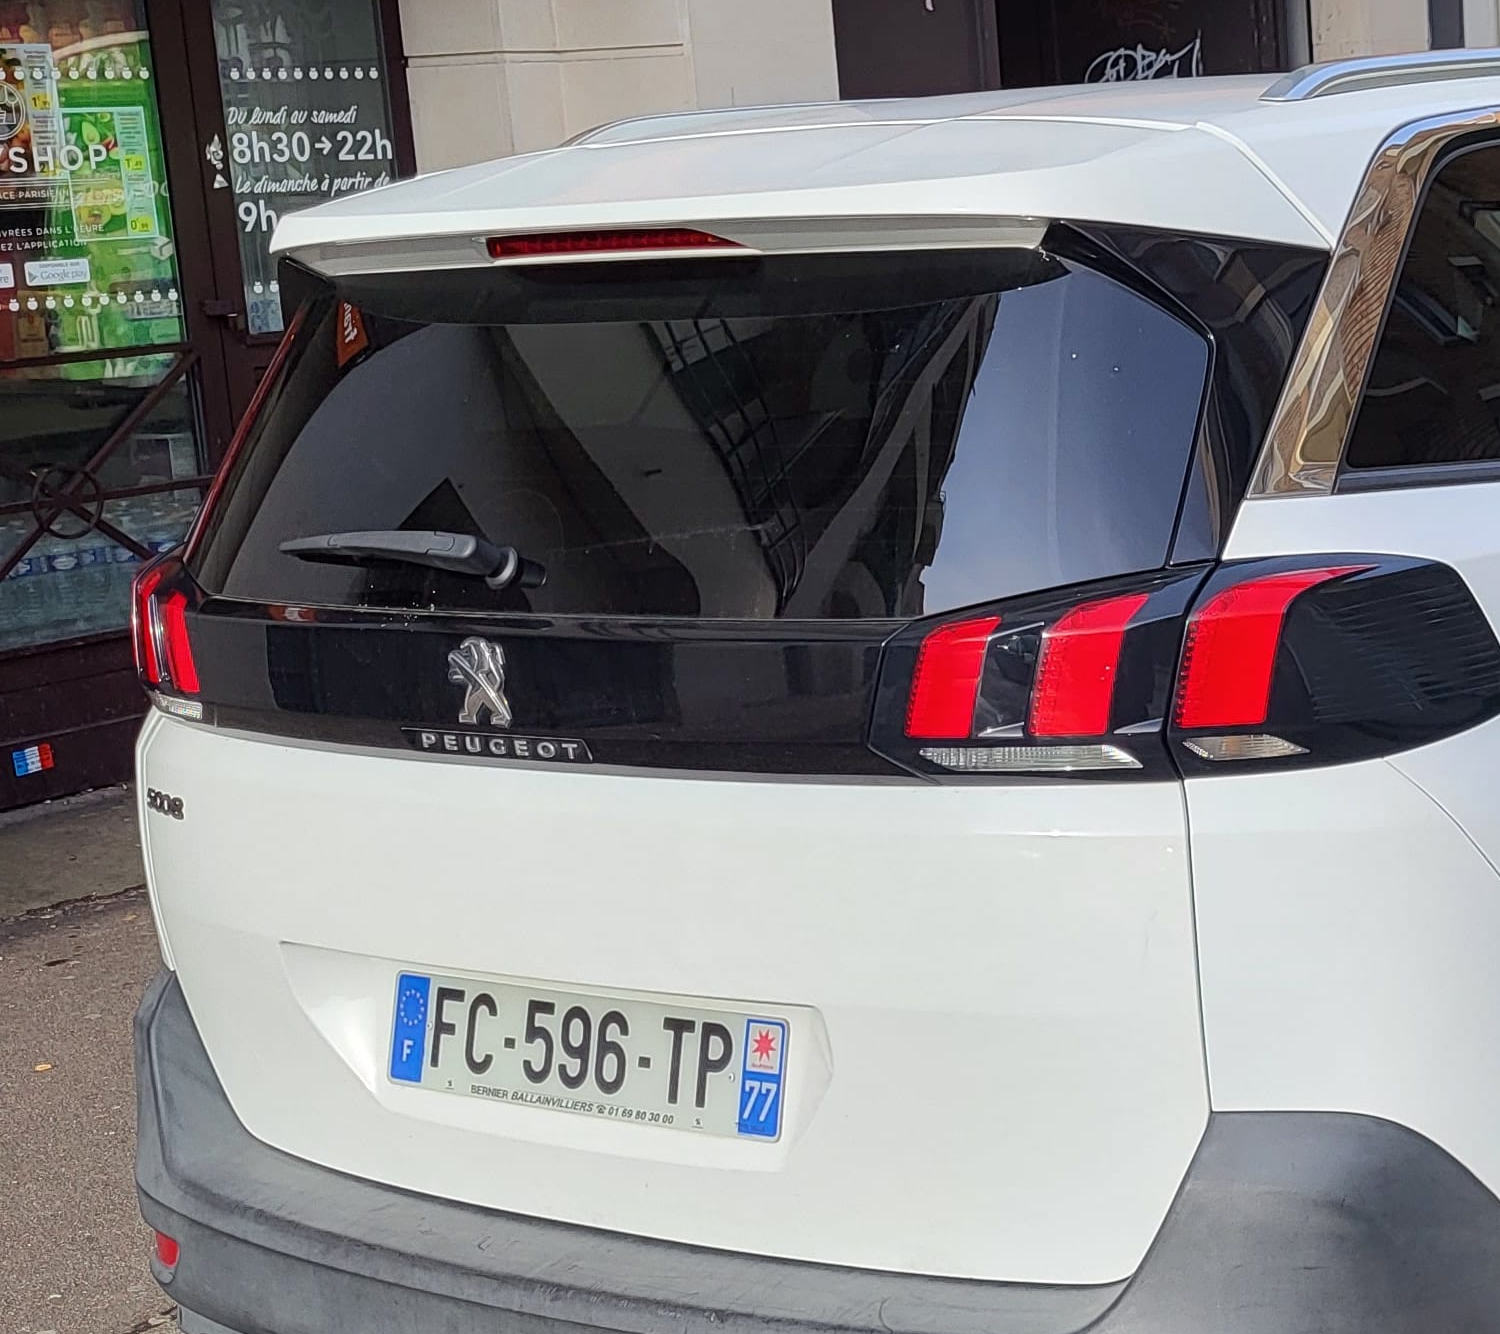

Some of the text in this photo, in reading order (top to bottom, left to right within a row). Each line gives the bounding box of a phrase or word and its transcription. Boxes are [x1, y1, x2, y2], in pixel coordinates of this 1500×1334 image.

[227, 105, 358, 124] Du lundi au samedi
[0, 145, 107, 173] SHOP
[232, 129, 393, 164] 8h30 22h
[235, 175, 251, 194] Le
[254, 175, 318, 193] dimanche
[320, 174, 330, 191] à
[331, 171, 372, 197] partir
[36, 227, 62, 235] DANS
[237, 199, 277, 233] 9h
[41, 269, 69, 281] Google
[421, 732, 578, 760] PEUGEOT
[147, 788, 184, 820] 5008
[402, 987, 734, 1109] F FC-596-TP
[471, 1085, 674, 1124] BERNIER BALLAINVILLIERS 01 69 80 30 00
[743, 1080, 778, 1122] 77
